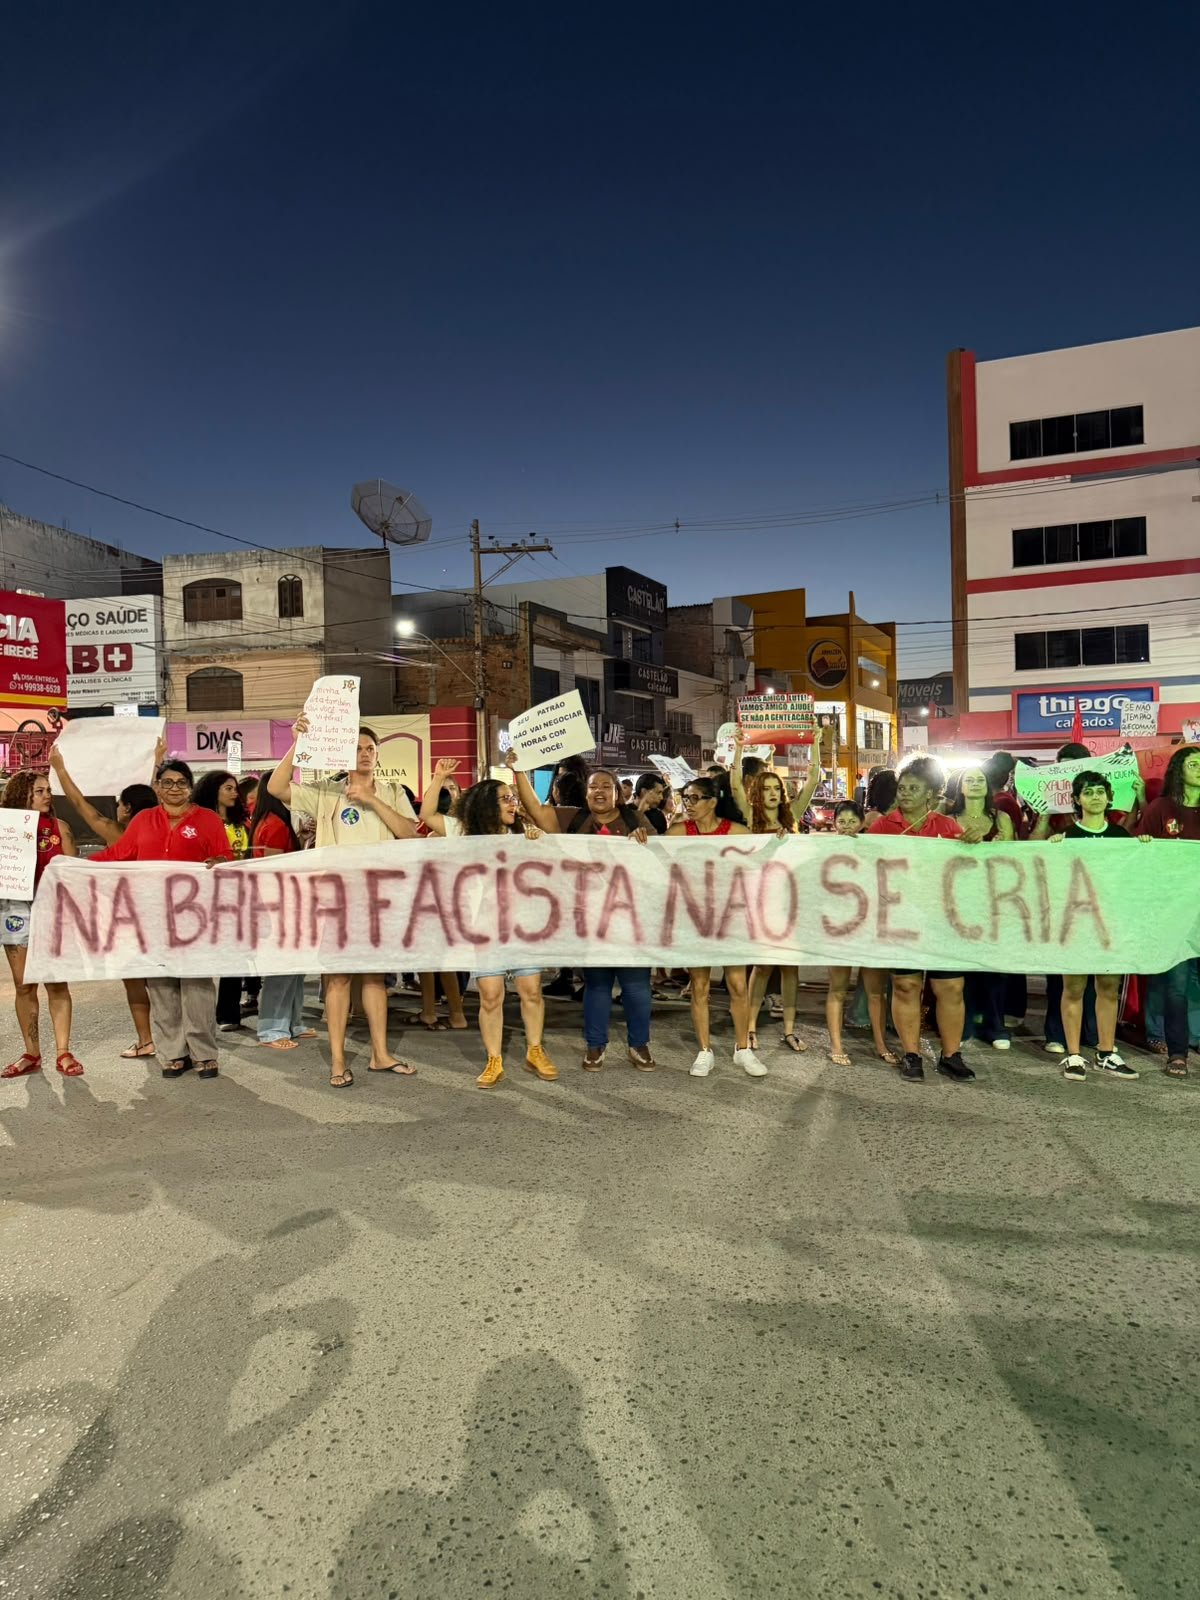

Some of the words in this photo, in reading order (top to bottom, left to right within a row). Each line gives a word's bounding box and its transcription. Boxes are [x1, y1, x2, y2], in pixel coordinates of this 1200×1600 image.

[627, 585, 665, 613] CASTELÃO
[66, 613, 89, 630] ÇO
[96, 606, 147, 626] SAÚDE
[4, 644, 38, 659] IRECÊ
[21, 674, 59, 683] DISK-ENTREGA
[638, 667, 668, 683] CASTELÃO
[517, 716, 529, 726] SEU
[537, 701, 566, 716] PATRÃO
[1039, 694, 1131, 717] thiago
[1125, 703, 1135, 712] SE
[1135, 702, 1151, 711] NÃO
[513, 730, 528, 740] NÃO
[530, 724, 543, 734] VAI
[543, 709, 583, 728] NEGOCIAR
[742, 714, 749, 722] SE
[751, 713, 764, 722] NÃO
[771, 713, 791, 721] GENTE
[1056, 716, 1114, 729] calados
[1125, 713, 1139, 721] TEM
[197, 728, 243, 751] DIVAS
[521, 735, 547, 749] HORAS
[549, 728, 567, 739] COM
[631, 739, 667, 752] CASTELÃO
[373, 768, 407, 776] TALINA
[52, 875, 147, 957] NA
[165, 869, 348, 950] BAHIA
[659, 845, 798, 946] NÃO
[820, 854, 920, 939] SE
[942, 854, 1111, 950] CRIA
